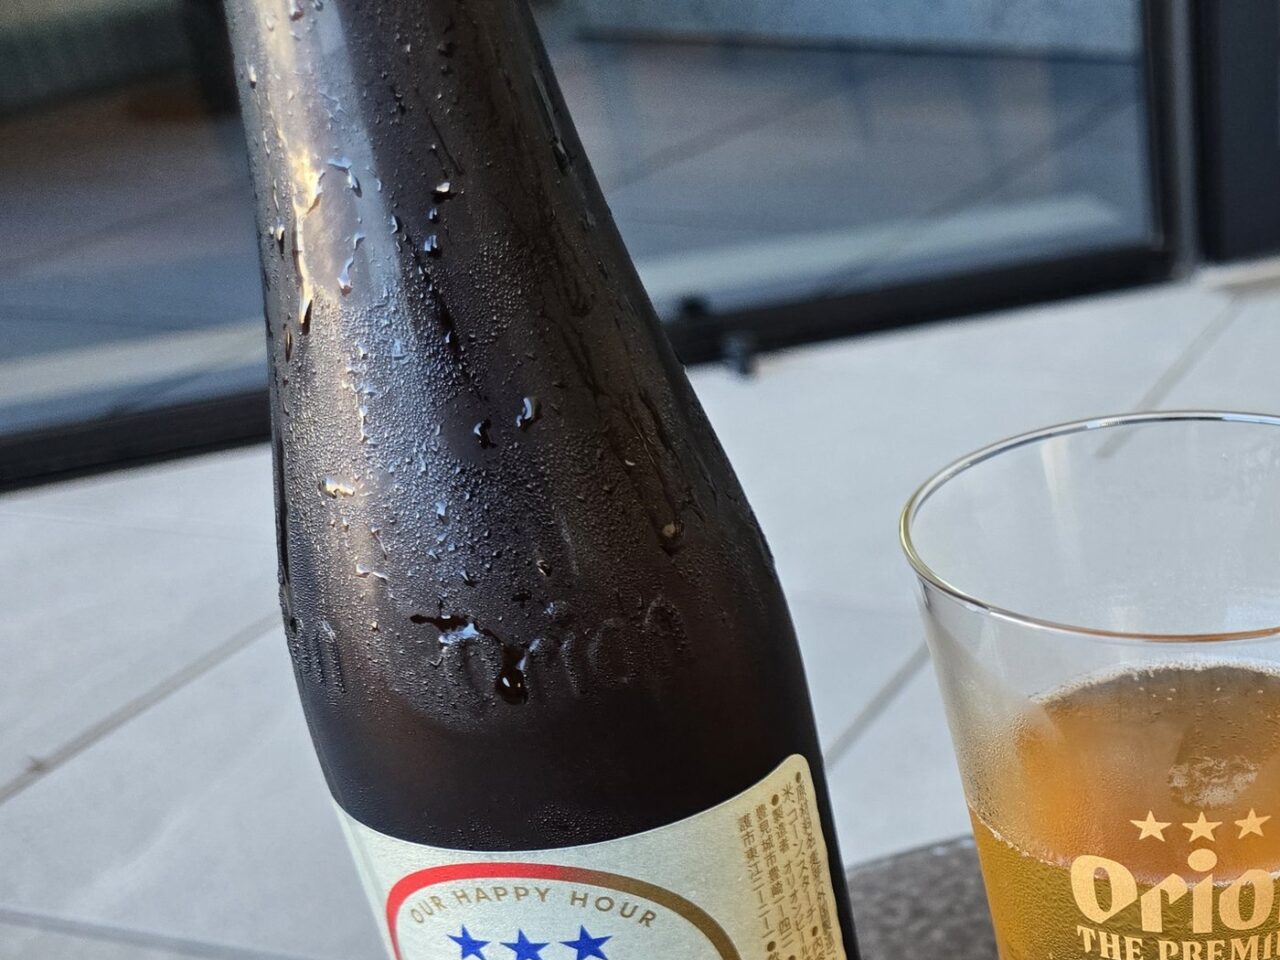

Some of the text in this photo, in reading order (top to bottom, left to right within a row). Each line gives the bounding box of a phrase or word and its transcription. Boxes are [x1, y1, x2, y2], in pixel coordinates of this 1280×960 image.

[410, 886, 657, 928] OUR HAPPY HOUR
